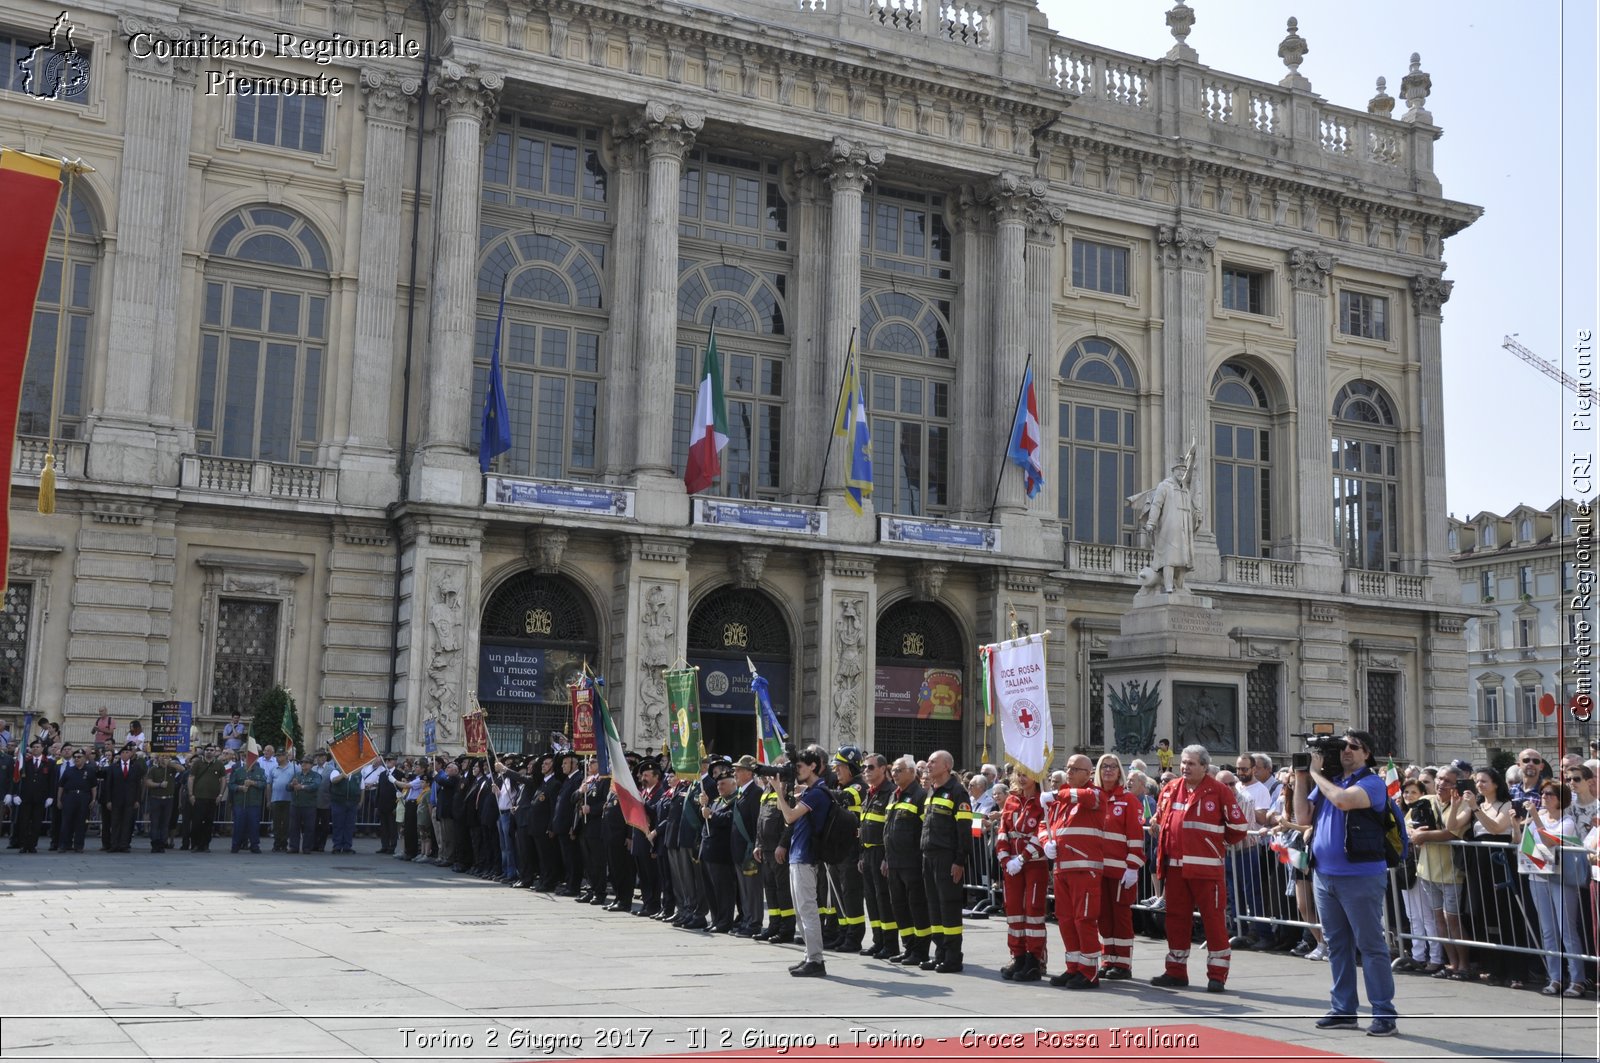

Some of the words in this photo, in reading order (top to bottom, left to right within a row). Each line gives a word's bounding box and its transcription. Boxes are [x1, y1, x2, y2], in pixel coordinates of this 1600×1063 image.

[514, 486, 538, 495] 150
[719, 507, 740, 516] 150
[904, 525, 923, 533] 150
[489, 654, 501, 662] un
[504, 652, 538, 665] palazzo
[508, 667, 538, 675] museo
[1018, 663, 1041, 675] ROSSA
[503, 675, 509, 685] il
[512, 678, 537, 687] cuore
[731, 674, 752, 684] palaz
[496, 686, 506, 697] di
[509, 688, 536, 698] torino
[890, 691, 911, 699] mondi
